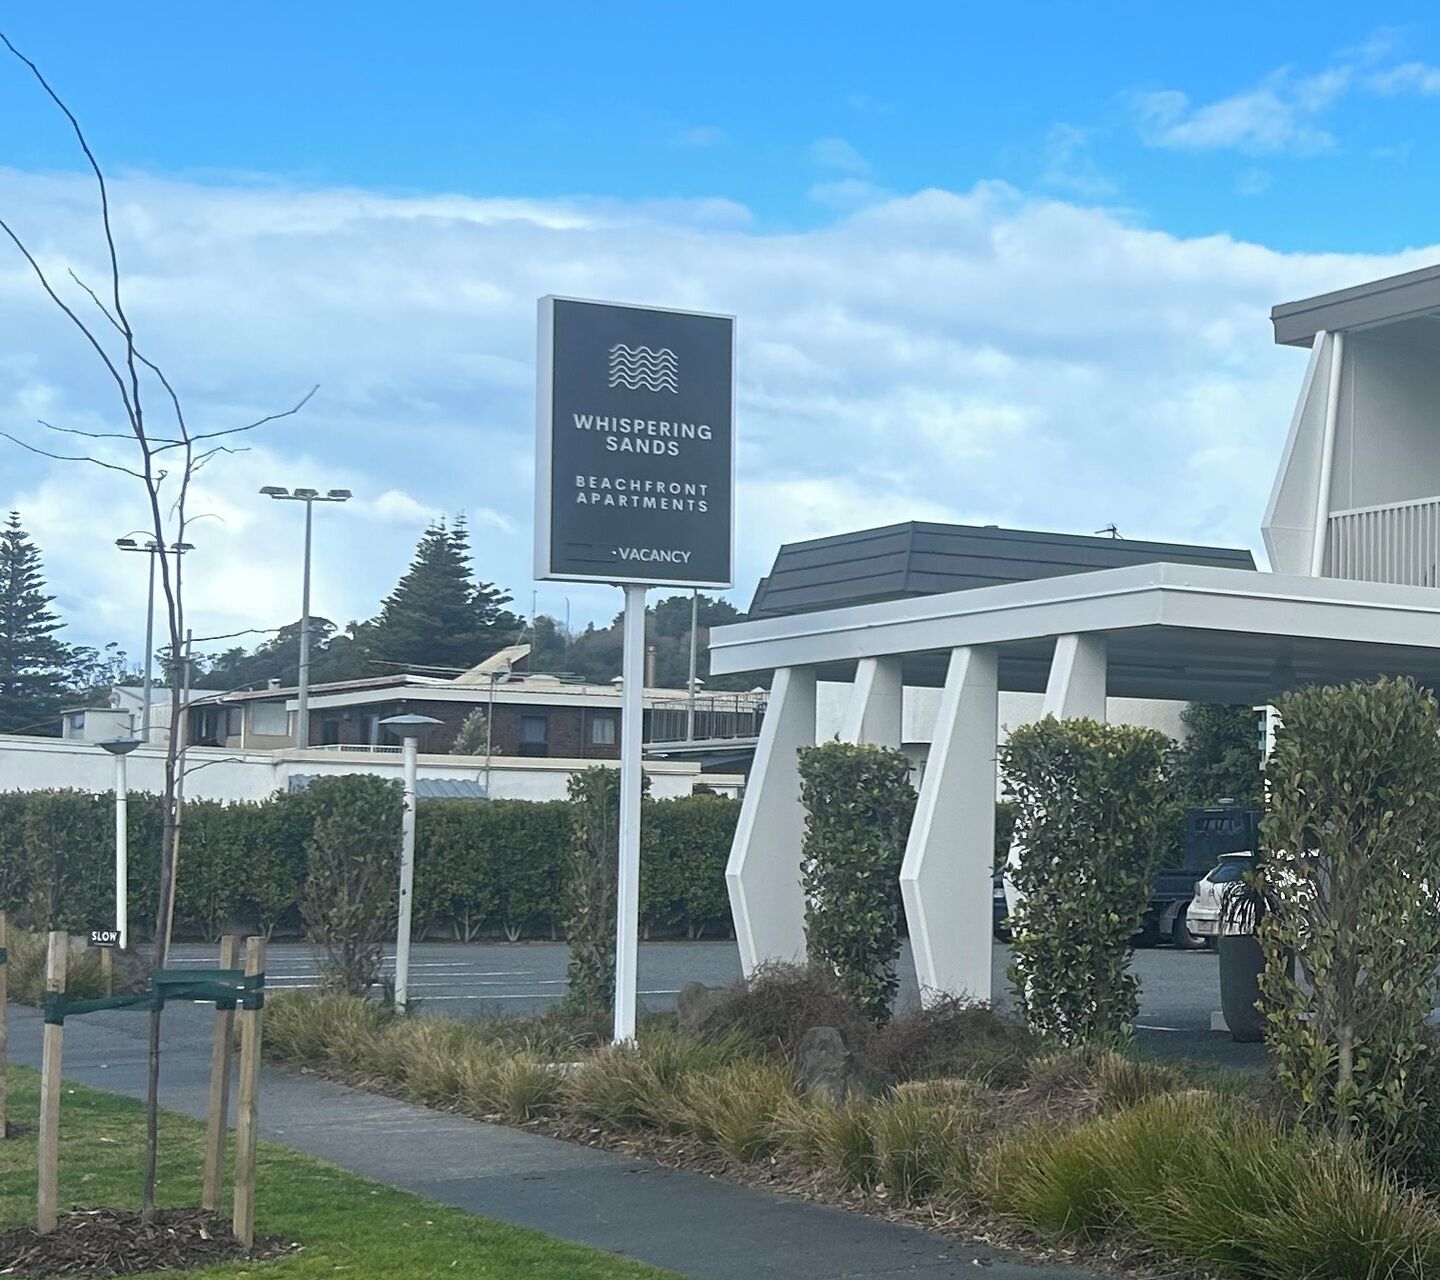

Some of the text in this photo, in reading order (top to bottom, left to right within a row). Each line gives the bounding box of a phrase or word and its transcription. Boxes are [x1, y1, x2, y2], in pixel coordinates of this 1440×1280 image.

[572, 413, 713, 441] WHISPERING
[606, 436, 680, 456] SANDS
[575, 475, 708, 496] BEACHFRONT
[576, 492, 708, 513] APARTMENTS
[618, 547, 692, 564] VACANCY
[91, 931, 118, 942] SLOW
